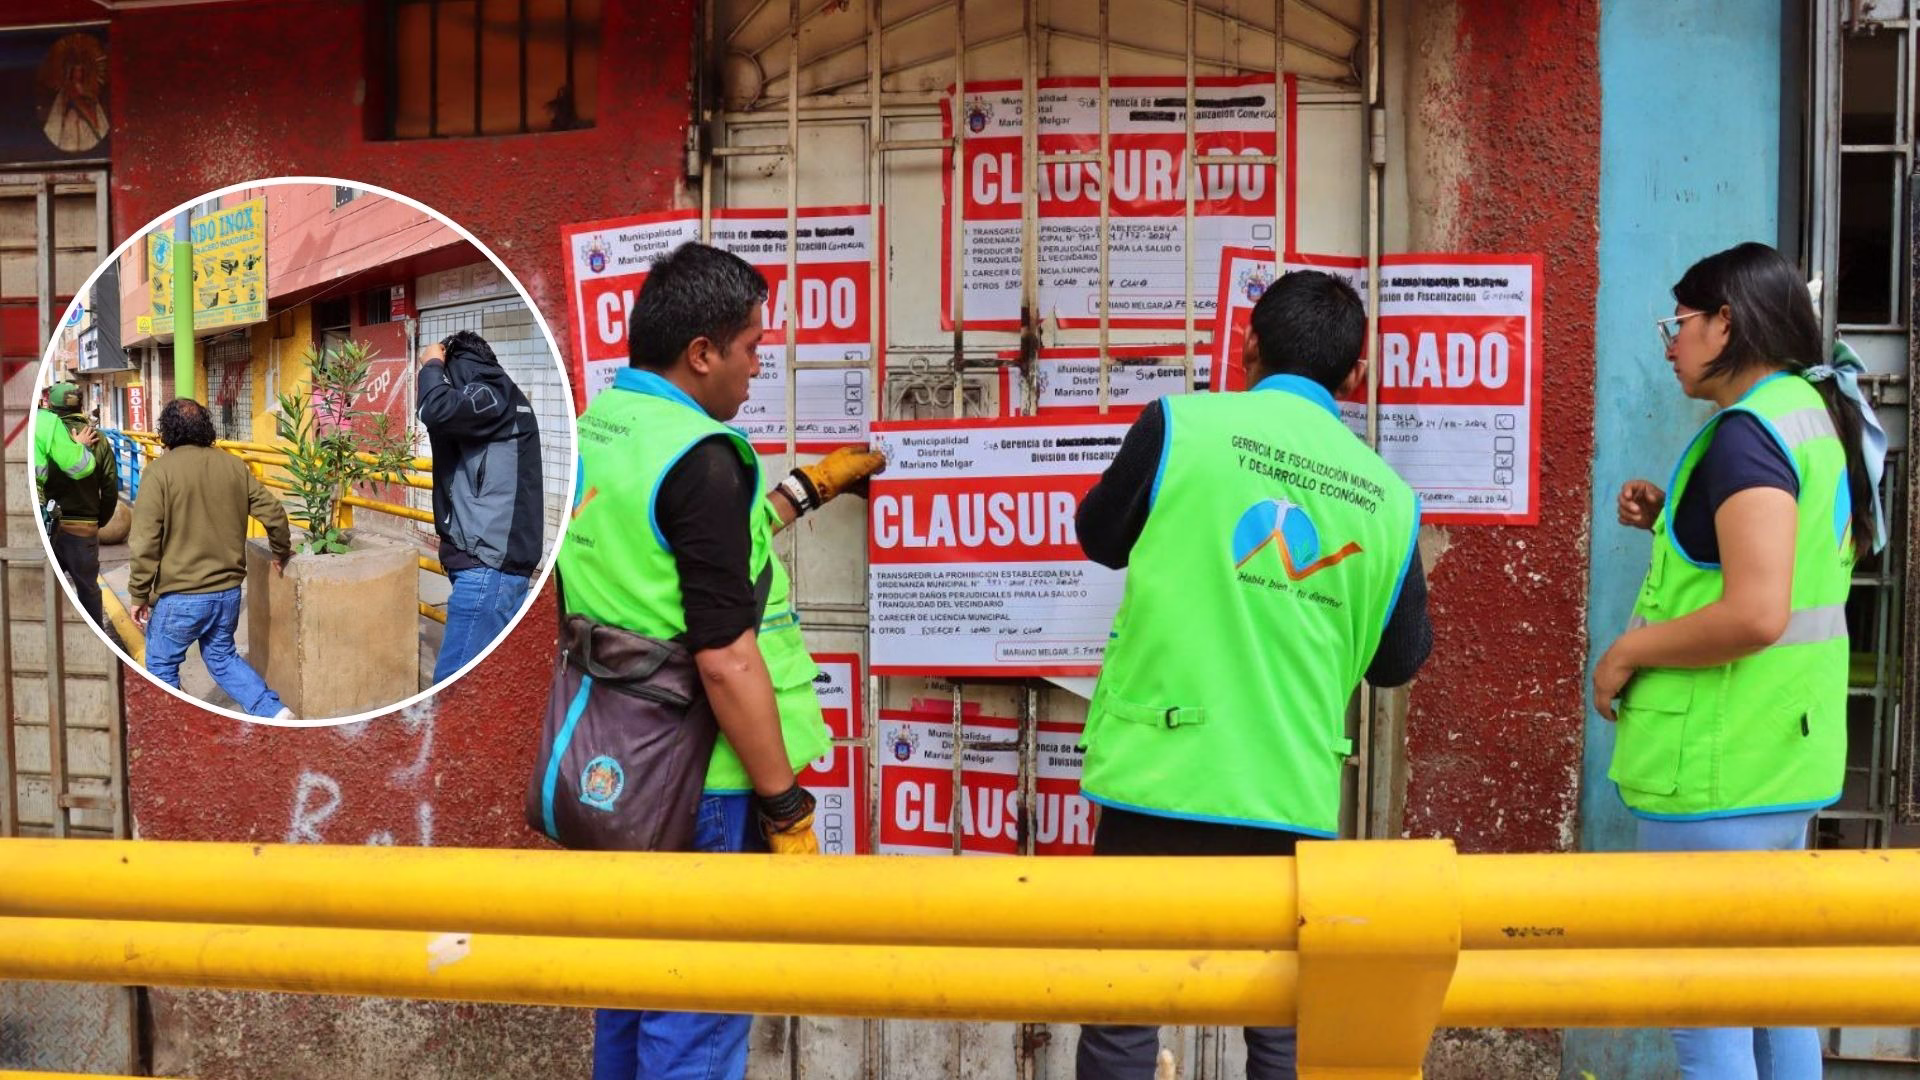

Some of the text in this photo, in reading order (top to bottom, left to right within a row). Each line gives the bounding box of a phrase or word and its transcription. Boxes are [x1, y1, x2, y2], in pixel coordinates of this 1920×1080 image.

[1001, 94, 1067, 105] Munalidad
[972, 147, 1266, 205] CLAUSURADO
[218, 207, 255, 237] INOX
[619, 228, 683, 242] Municipalidad
[633, 241, 669, 252] Distrital
[1061, 266, 1101, 274] MUNICIPA
[972, 282, 1000, 290] OTROS
[1417, 291, 1476, 302] Fiscalización
[1054, 387, 1094, 397] Mariano
[130, 387, 143, 431] BOTIC
[902, 435, 969, 447] Municipalidad
[1000, 438, 1040, 449] Gerencia
[1042, 438, 1053, 448] de
[917, 448, 955, 457] Distrital
[1031, 451, 1066, 463] División
[1068, 451, 1079, 462] de
[900, 458, 974, 470] Mariano Melgar
[1231, 435, 1271, 459] GERENCIA
[1274, 449, 1285, 463] DE
[1288, 453, 1349, 483] FISCALIZACIÓN
[1239, 454, 1376, 515] Y DESARROLLO ECONÓMICO
[873, 491, 1078, 549] CLAUSUR
[877, 571, 932, 579] TRANSGREDIR
[933, 571, 945, 579] LA
[1001, 570, 1057, 578] ESTABLECIDA
[1059, 569, 1071, 577] EN
[1072, 569, 1084, 577] LA
[877, 581, 925, 589] ORDENANZA
[926, 580, 968, 588] MUNICIPAL
[919, 590, 947, 599] DAÑOS
[948, 590, 1011, 599] PERJUDICIALES
[1014, 590, 1037, 598] PARA
[1038, 590, 1050, 598] LA
[1050, 590, 1079, 598] SALUD
[877, 600, 1004, 608] TRANQUILIDAD DEL VECINDARIO
[930, 613, 966, 621] LICENCIA
[967, 613, 1011, 621] MUNICIPAL
[878, 626, 906, 635] OTROS
[1002, 648, 1038, 656] MARIANO
[963, 752, 995, 765] Melgar
[895, 780, 1095, 846] CLAUSUR
